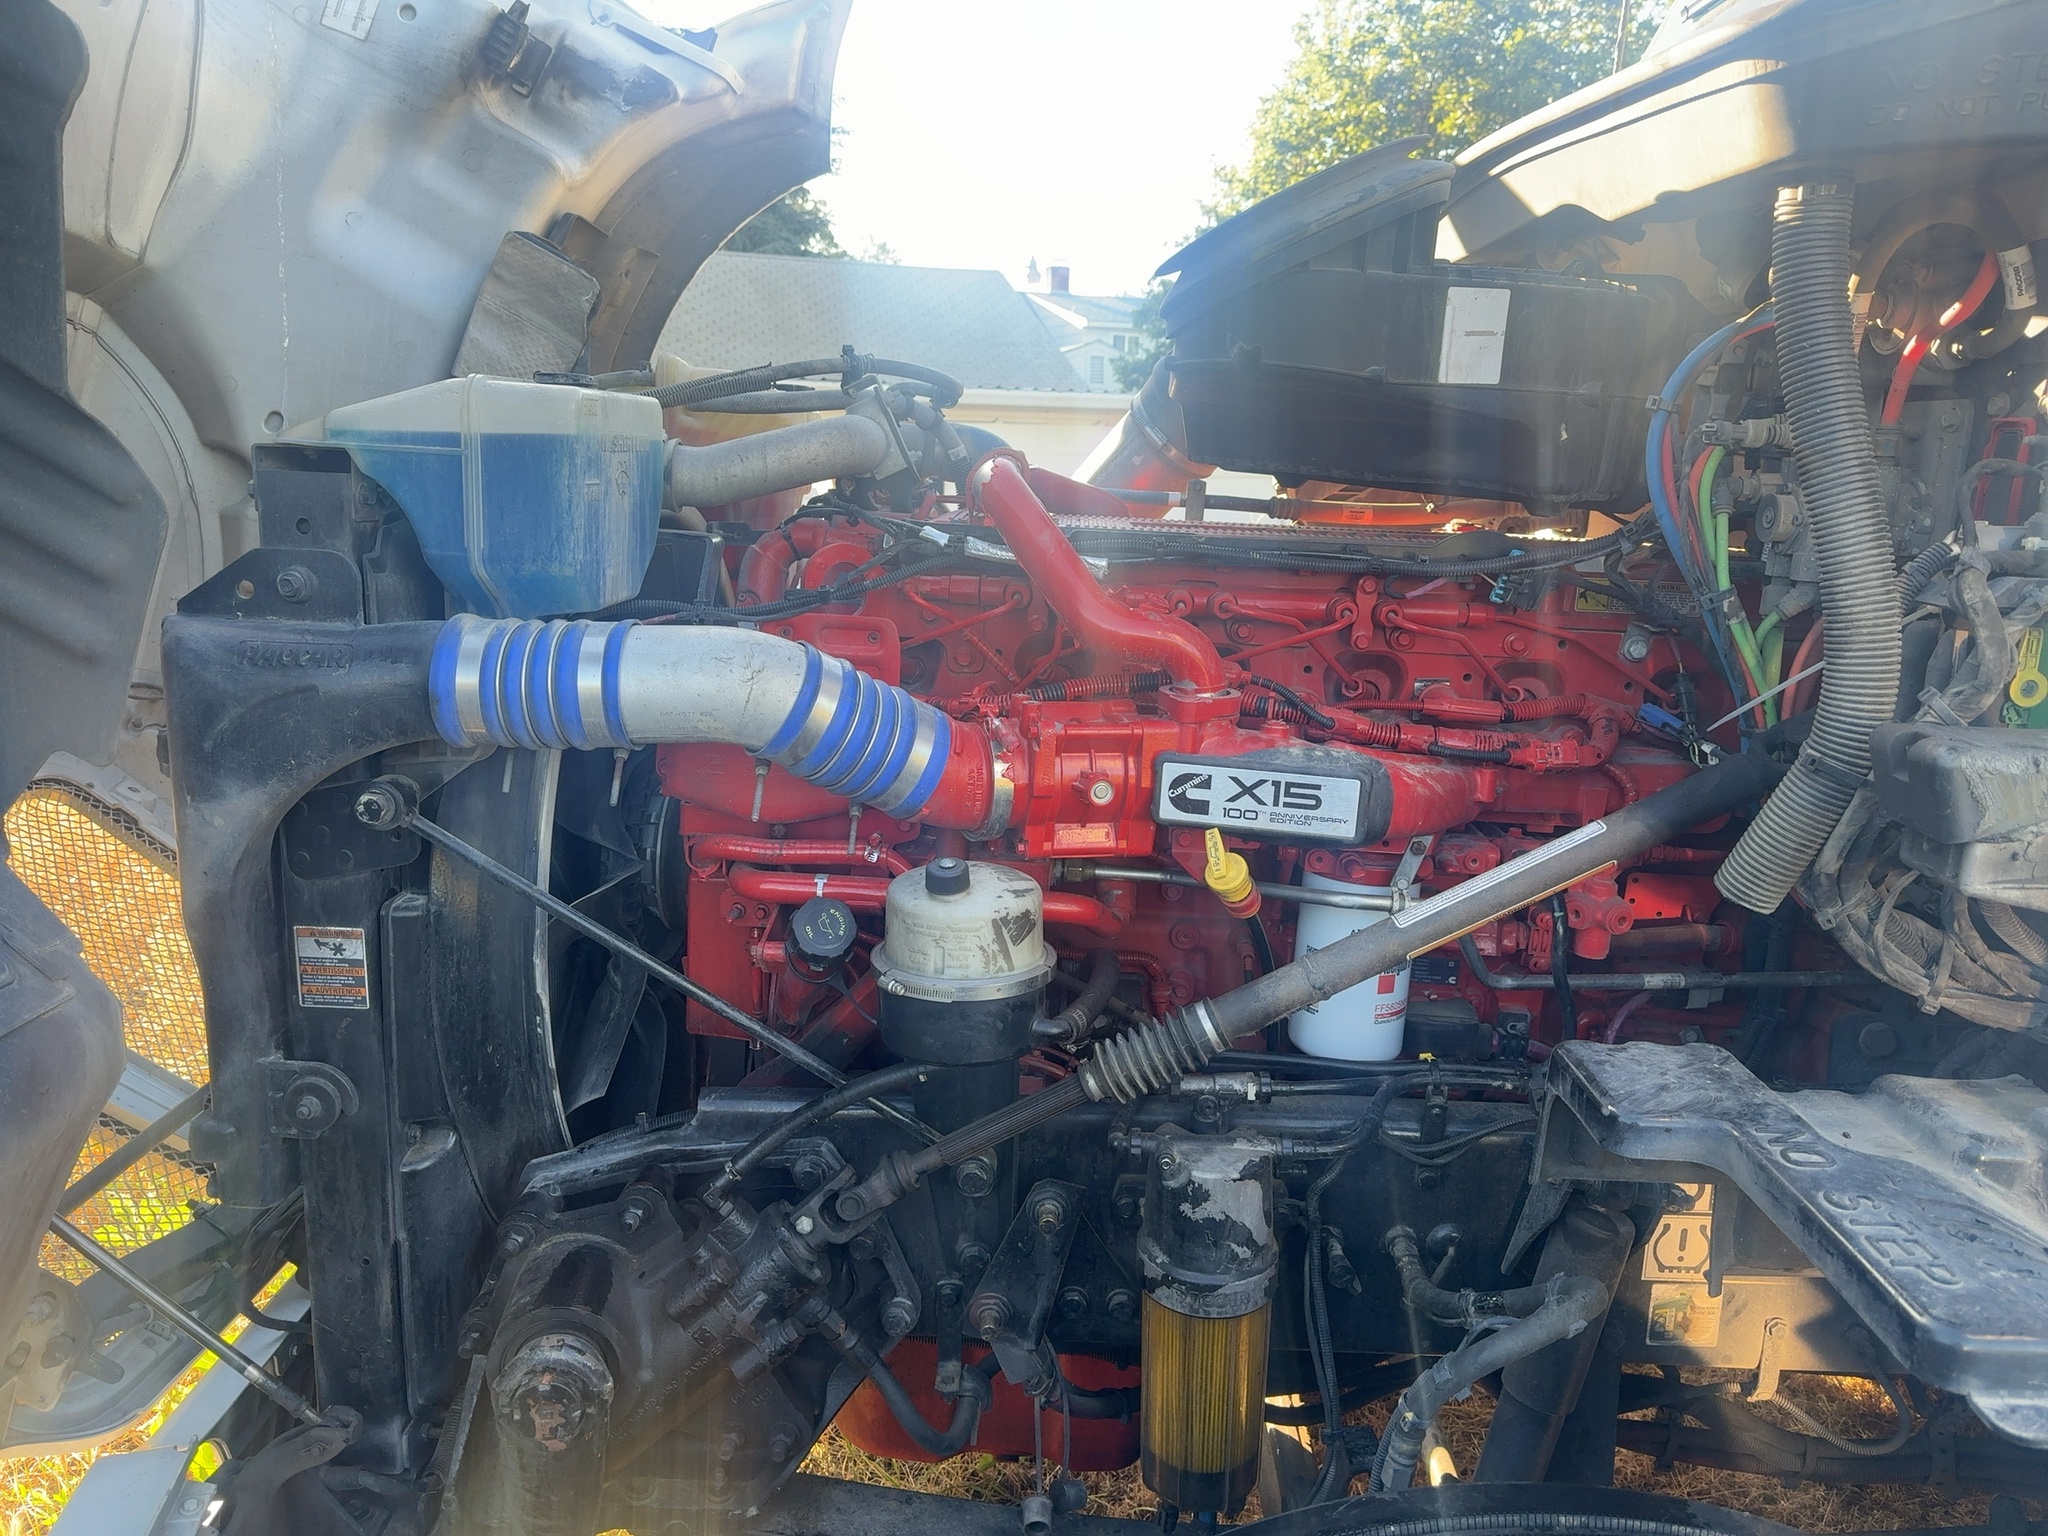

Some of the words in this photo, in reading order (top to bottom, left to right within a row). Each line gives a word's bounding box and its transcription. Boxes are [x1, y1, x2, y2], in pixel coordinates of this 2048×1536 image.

[2013, 265, 2024, 297] PACCAR
[1168, 773, 1209, 798] Cummins
[1224, 775, 1323, 811] X15
[1269, 812, 1349, 825] ANNIVERSARY
[1269, 817, 1312, 827] EDITION
[829, 908, 846, 936] ENGINE
[805, 925, 814, 939] OIL
[310, 966, 363, 975] AVERTISSEMENT
[315, 987, 363, 995] ADVERTENCIA
[1754, 1126, 1838, 1170] NO
[1821, 1189, 1963, 1287] STEP
